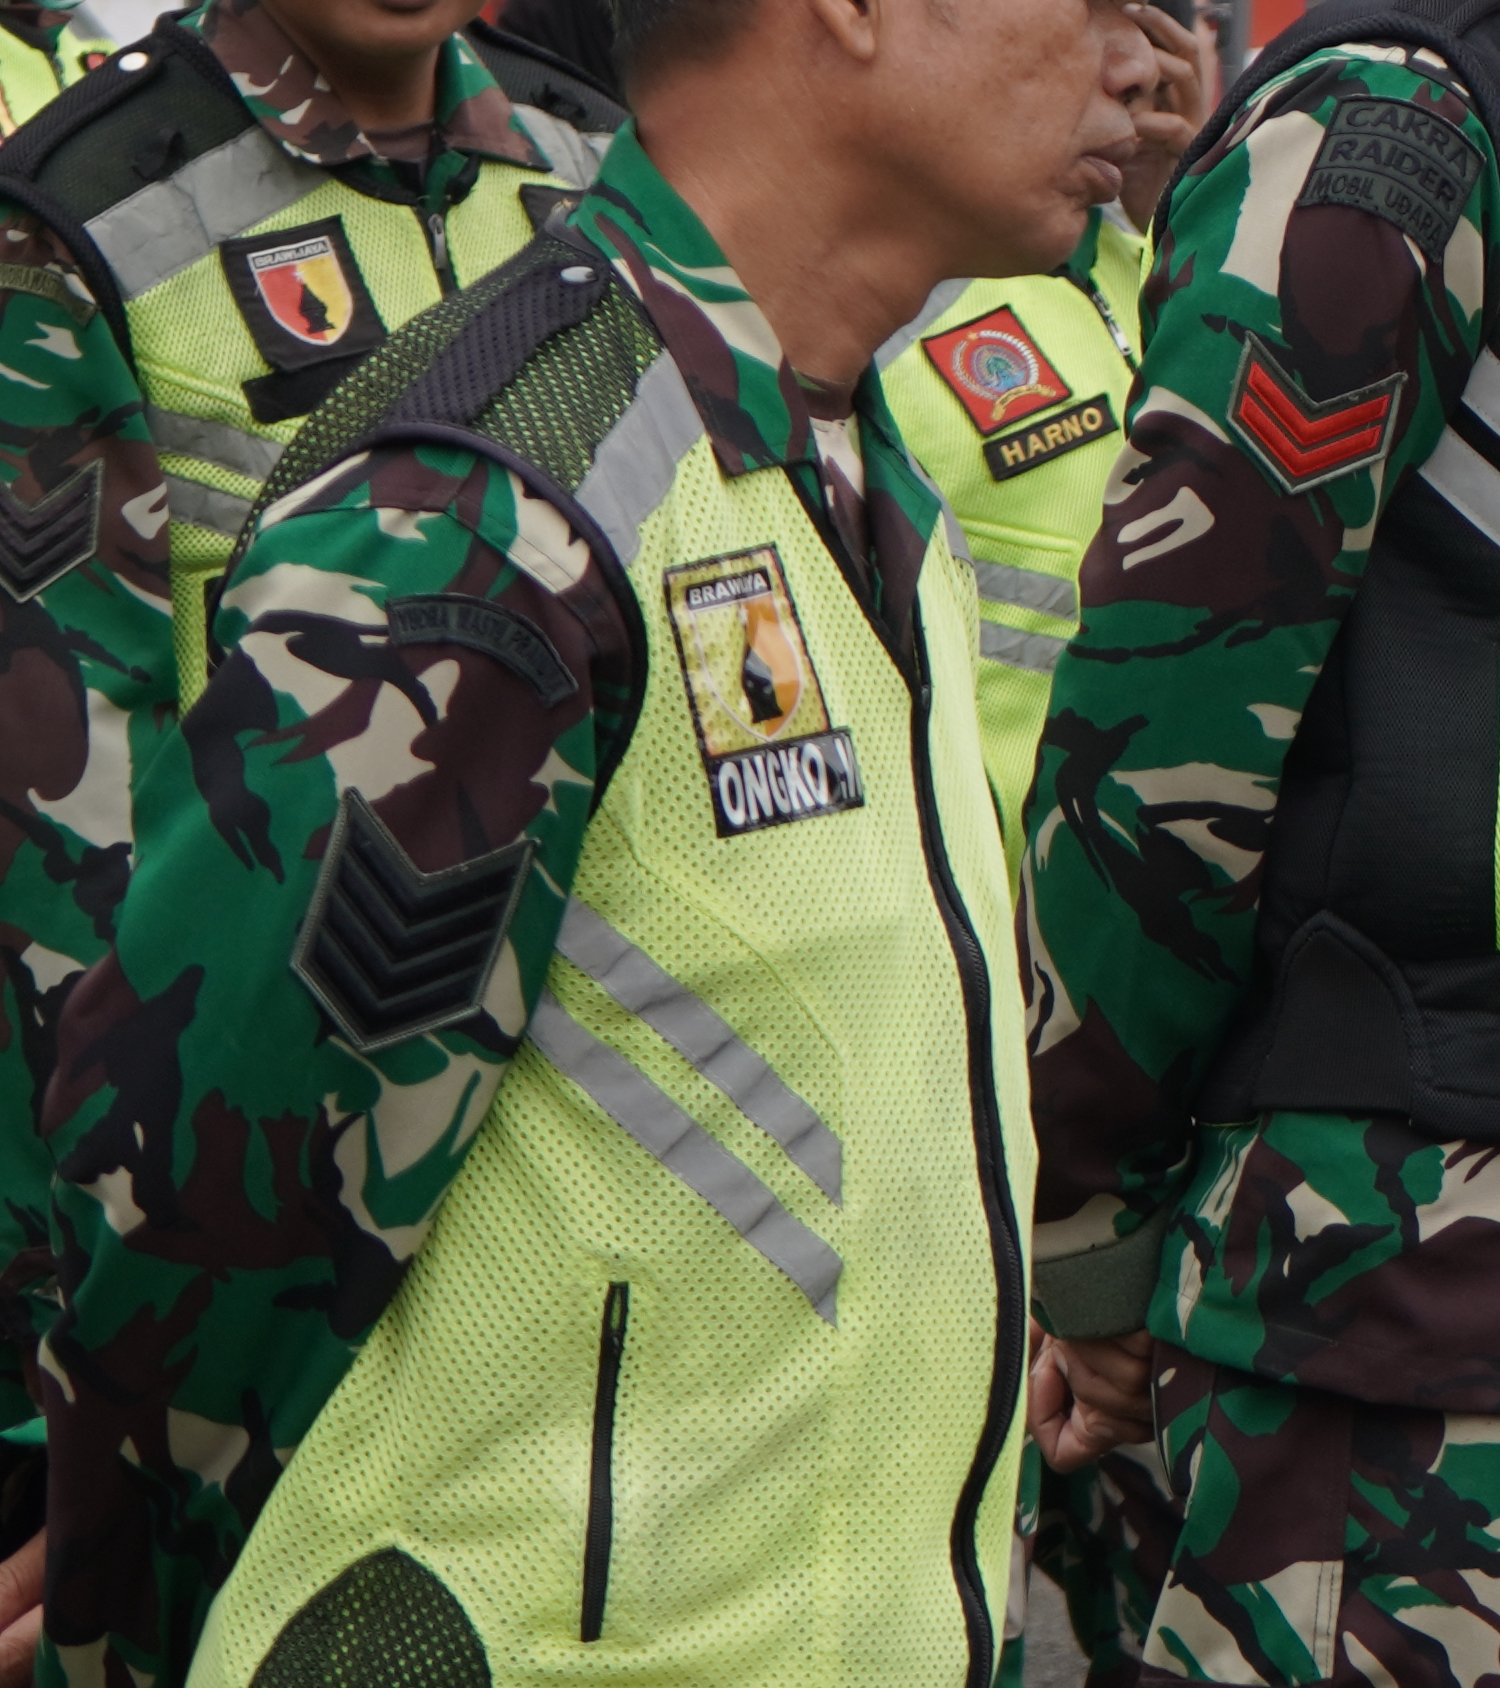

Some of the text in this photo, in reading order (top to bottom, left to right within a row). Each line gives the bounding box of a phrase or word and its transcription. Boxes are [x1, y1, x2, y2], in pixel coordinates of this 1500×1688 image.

[1329, 138, 1457, 212] RAIDER
[1346, 106, 1468, 178] CAKRA
[1309, 172, 1443, 246] MOBIL UDARA
[1000, 406, 1102, 467] HARNO
[716, 741, 830, 827] ONGKO
